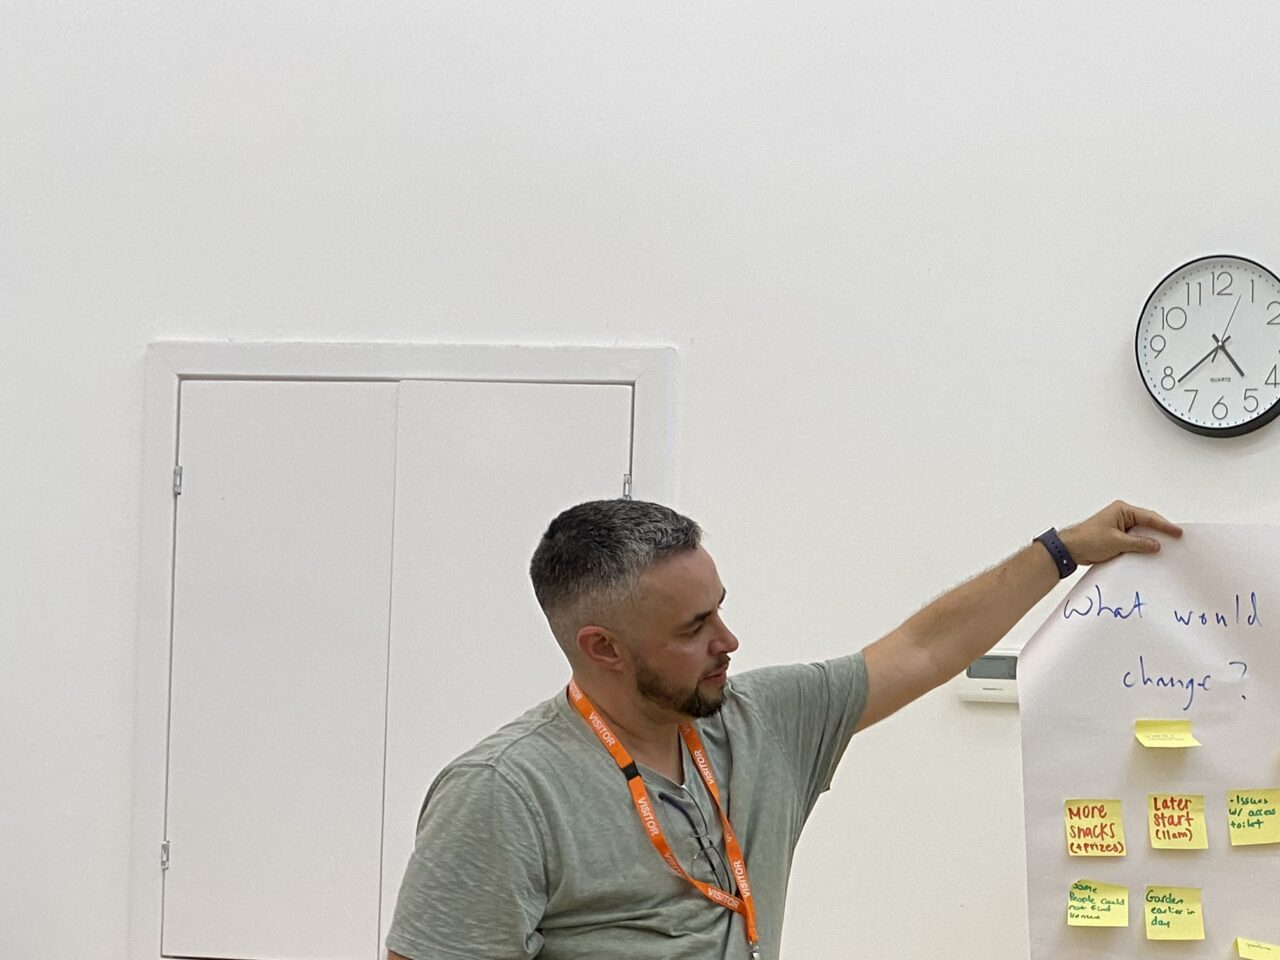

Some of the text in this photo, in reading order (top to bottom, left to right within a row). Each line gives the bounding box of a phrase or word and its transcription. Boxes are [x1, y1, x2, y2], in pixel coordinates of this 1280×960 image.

[1185, 282, 1202, 306] 11
[1211, 271, 1233, 296] 12
[1161, 306, 1187, 330] 10
[1150, 334, 1166, 359] 9
[1160, 365, 1176, 390] 8
[1264, 364, 1280, 388] 4
[1184, 389, 1198, 413] 7
[1211, 395, 1229, 420] 6
[1243, 388, 1259, 412] 5
[1174, 591, 1263, 627] would
[588, 711, 616, 747] VISITOR
[693, 749, 714, 785] VISITOR
[1153, 796, 1192, 811] Later
[637, 796, 660, 837] VISITOR
[733, 860, 751, 897] VISITOR
[707, 887, 740, 910] VISITOR
[1146, 889, 1184, 904] Garden
[1151, 906, 1183, 914] earlier
[1151, 915, 1170, 928] day
